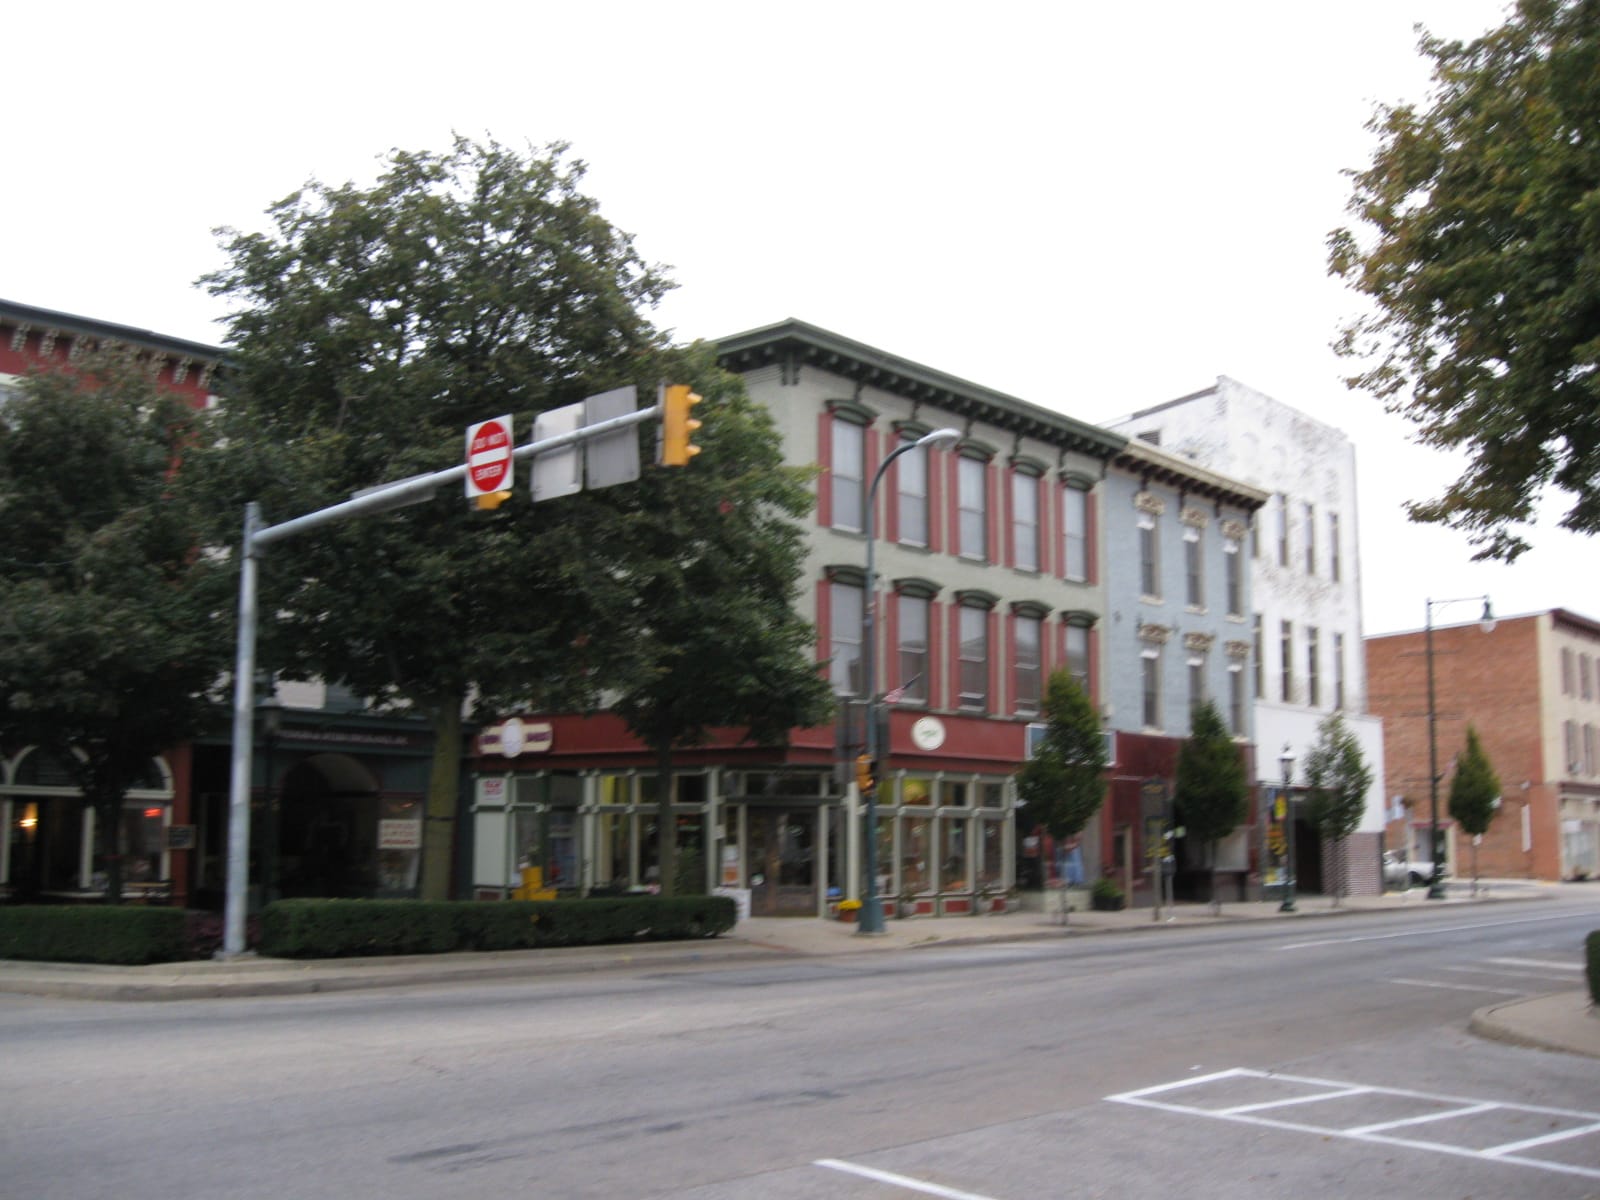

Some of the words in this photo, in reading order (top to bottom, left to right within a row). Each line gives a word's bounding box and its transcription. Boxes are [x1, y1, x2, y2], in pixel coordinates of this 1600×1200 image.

[473, 437, 486, 450] DO
[488, 432, 505, 445] NOT
[475, 464, 503, 480] ENTER
